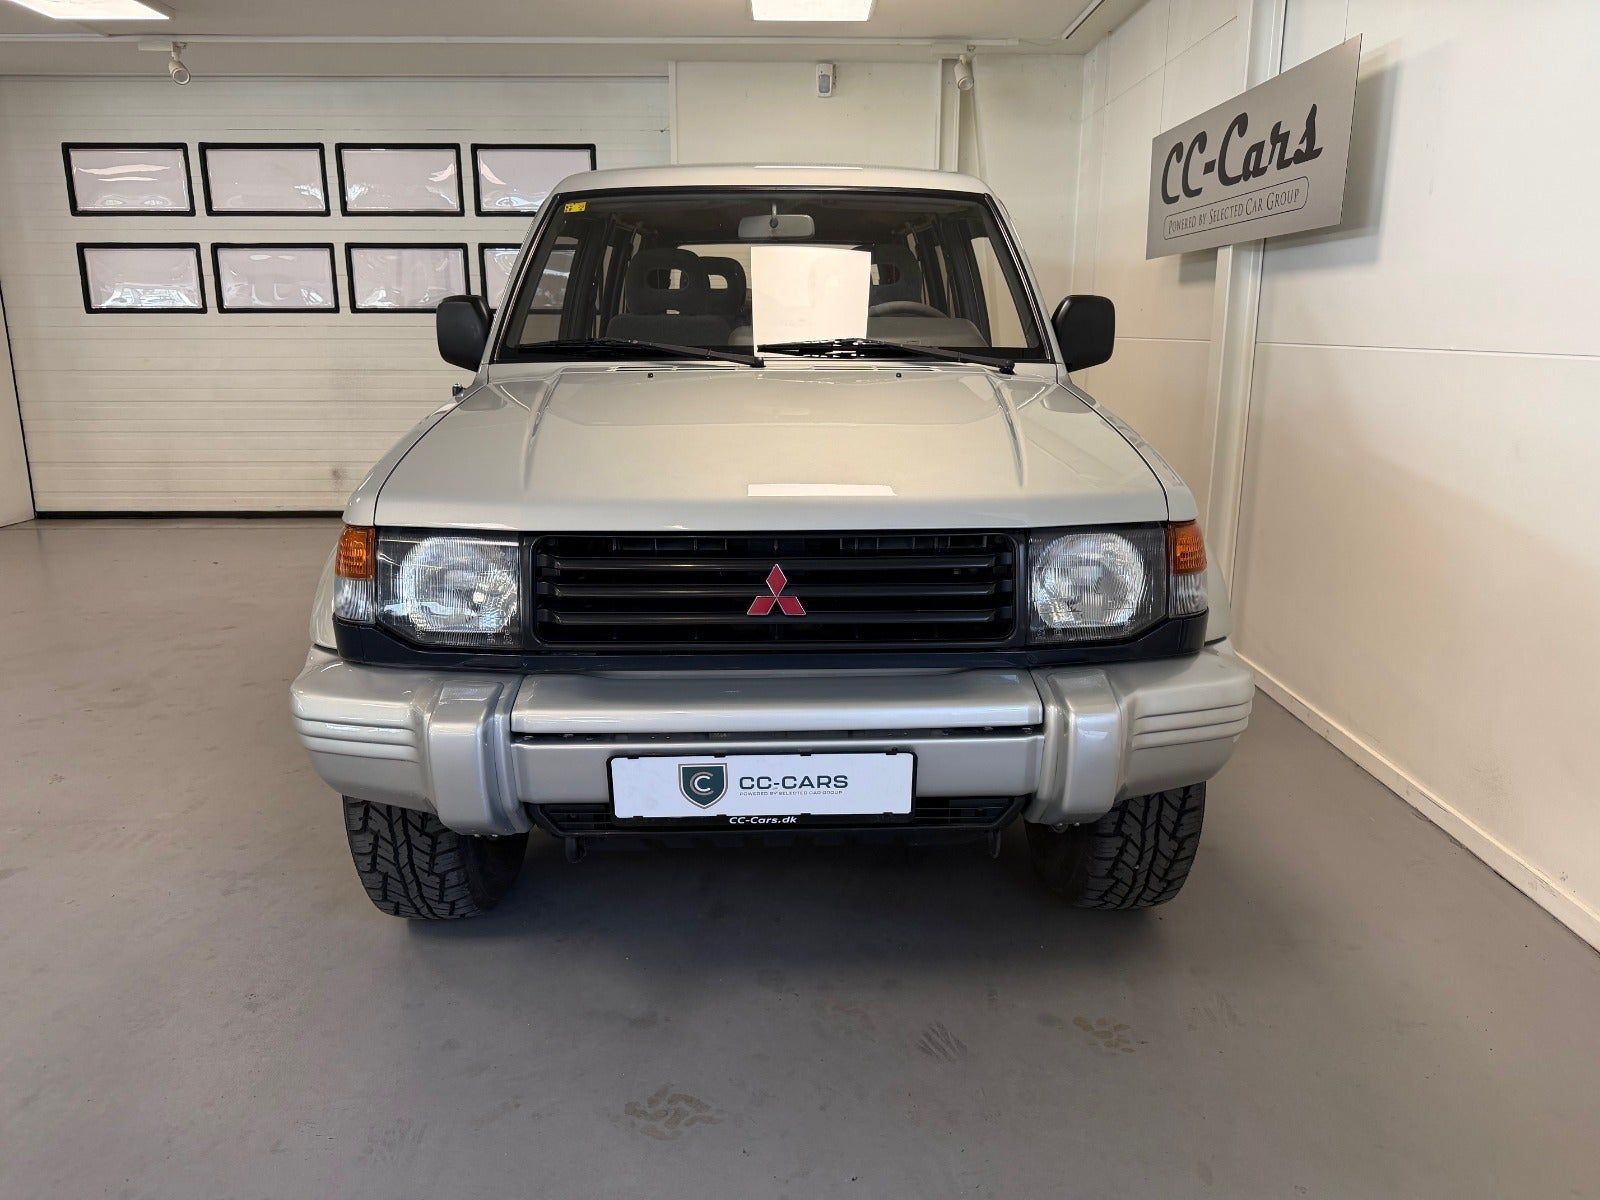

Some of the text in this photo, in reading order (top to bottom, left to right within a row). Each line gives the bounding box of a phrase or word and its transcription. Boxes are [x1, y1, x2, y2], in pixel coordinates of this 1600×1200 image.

[1161, 103, 1323, 205] CC-Cars
[739, 775, 849, 790] CC-CARS
[729, 816, 798, 824] CC-Cars.dk
